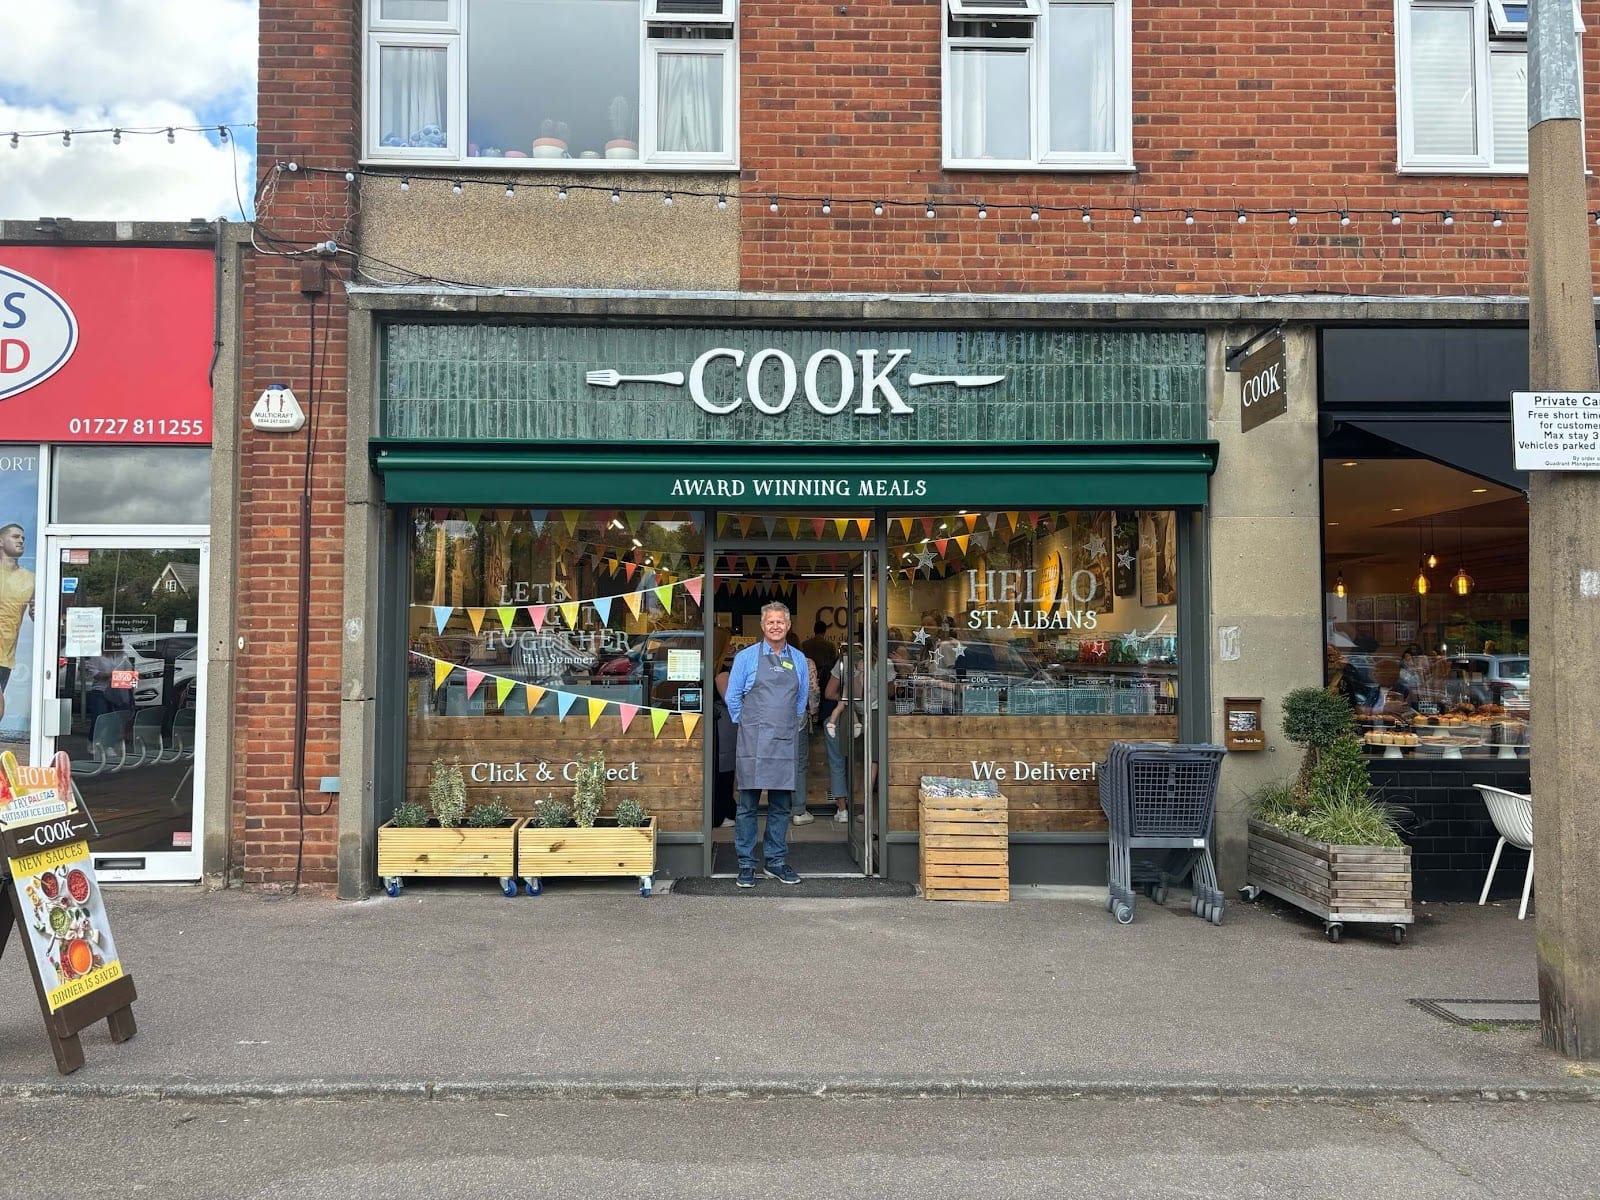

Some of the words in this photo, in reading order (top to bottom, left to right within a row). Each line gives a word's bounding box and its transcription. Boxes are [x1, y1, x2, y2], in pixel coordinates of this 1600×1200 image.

[689, 348, 914, 415] COOK
[1243, 362, 1280, 407] COOK
[1534, 396, 1577, 406] Private
[1528, 410, 1549, 419] Free
[1553, 410, 1579, 419] short
[69, 418, 129, 434] 01727
[132, 418, 203, 435] 811255
[1540, 421, 1553, 430] for
[1518, 441, 1559, 450] Vehicles
[1562, 441, 1596, 451] parked
[1544, 431, 1564, 440] Max
[1568, 431, 1589, 441] stay
[671, 479, 745, 497] AWARD
[752, 479, 851, 496] WINNING
[858, 479, 927, 496] MEALS
[967, 569, 1097, 603] HELLO
[544, 605, 598, 627] GT
[967, 610, 1002, 630] ST.
[1007, 610, 1098, 630] ALBANS
[482, 629, 632, 652] TOGETHER
[523, 653, 545, 665] this
[548, 654, 595, 665] Summer
[16, 767, 57, 786] HOT?
[471, 761, 529, 782] Click
[535, 761, 555, 782] &
[970, 760, 1007, 780] We
[1013, 760, 1097, 781] Deliver!
[13, 799, 29, 810] TRY
[28, 790, 55, 805] PALETAS
[30, 808, 42, 817] ICE
[34, 820, 76, 846] COOK
[18, 855, 42, 873] NEW
[45, 843, 83, 864] SAUCES
[52, 983, 85, 1005] DINNER
[84, 978, 94, 990] IS
[95, 966, 119, 985] SAVED
